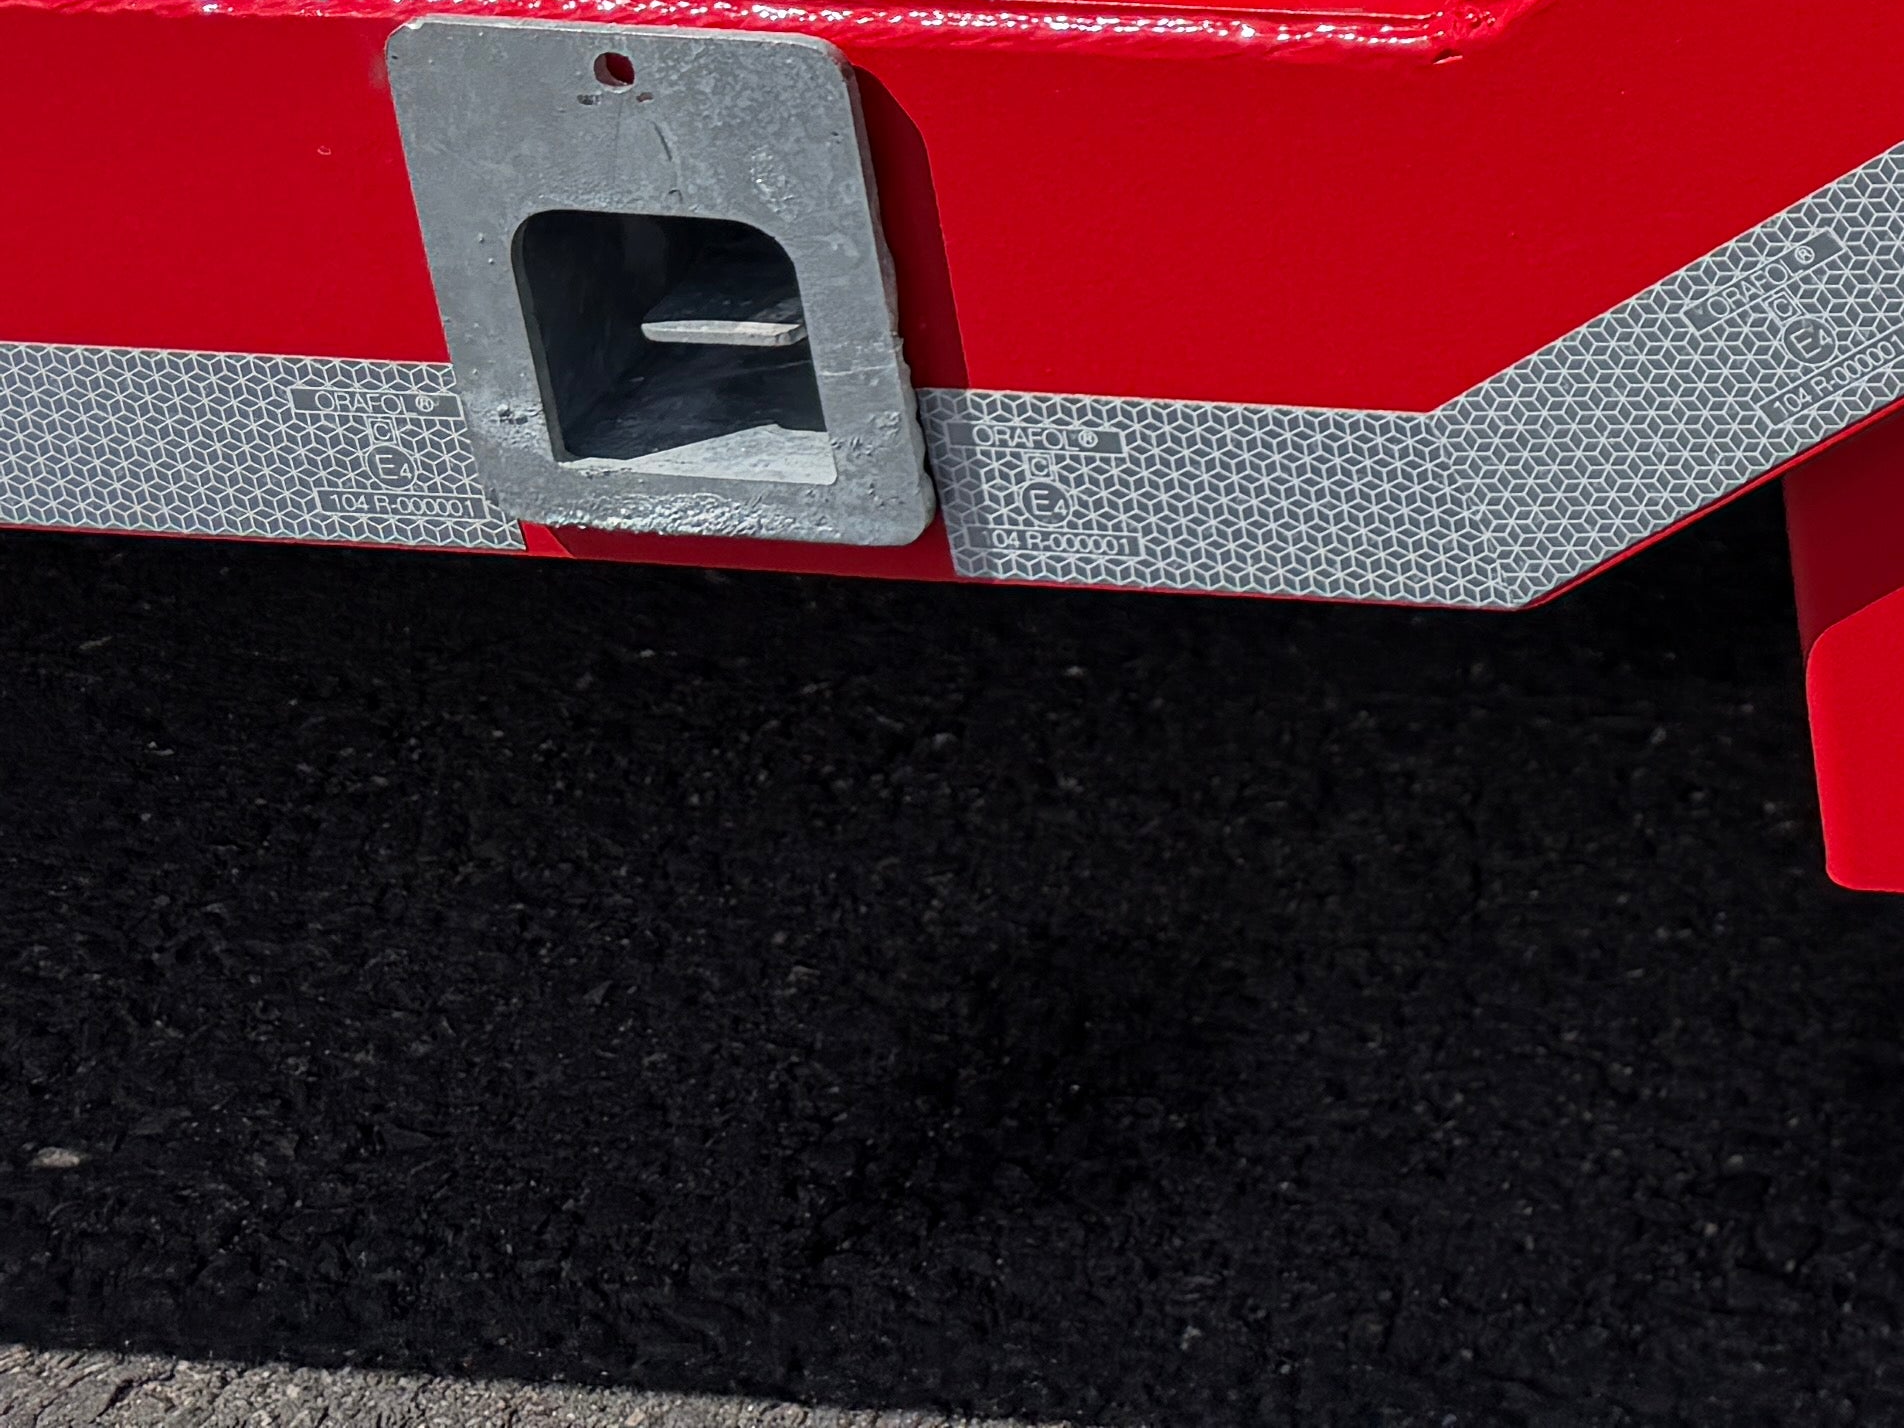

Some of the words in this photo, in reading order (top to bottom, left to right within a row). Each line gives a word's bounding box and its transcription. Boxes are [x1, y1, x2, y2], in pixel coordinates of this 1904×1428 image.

[1773, 387, 1812, 417] 104
[329, 494, 369, 512] 104
[373, 495, 475, 517] R-000001
[980, 530, 1021, 549] 104
[1025, 530, 1130, 555] R-000001
